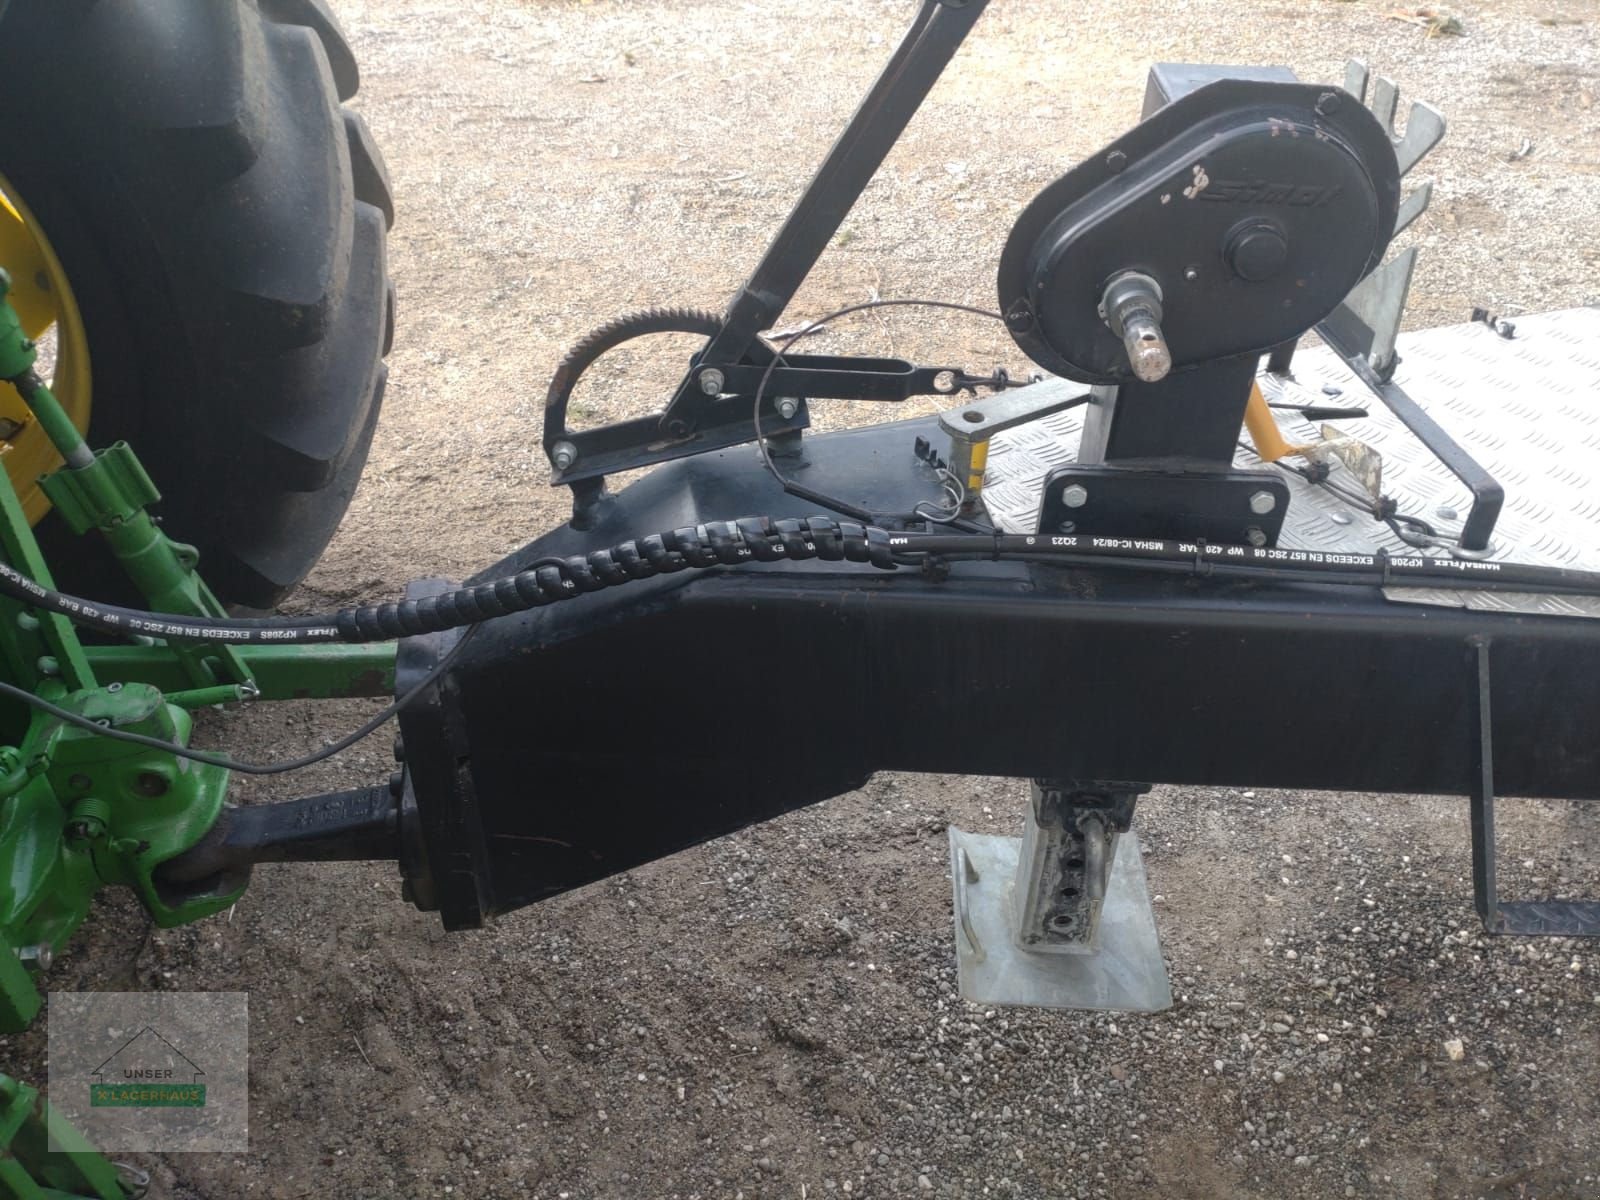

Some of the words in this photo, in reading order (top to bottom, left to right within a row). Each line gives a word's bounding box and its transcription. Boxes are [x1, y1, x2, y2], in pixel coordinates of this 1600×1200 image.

[1051, 536, 1077, 546] 2Q23
[1093, 537, 1132, 549] IC-08/24
[1134, 541, 1164, 551] MSHA
[1205, 545, 1223, 554] 420
[1227, 548, 1244, 556] WP
[1254, 549, 1267, 558] 08
[1268, 550, 1288, 560] 2SC
[1290, 552, 1307, 561] 857
[1309, 553, 1323, 563] EN
[1326, 554, 1374, 565] EXCEEDS
[1391, 557, 1423, 568] KP208
[21, 578, 47, 598] MSHA
[58, 597, 80, 612] BAR
[82, 606, 100, 618] 420
[143, 622, 164, 633] 2SC
[165, 625, 183, 635] 857
[184, 627, 200, 635] EN
[202, 628, 250, 639] EXCEEDS
[260, 630, 297, 640] KP208S
